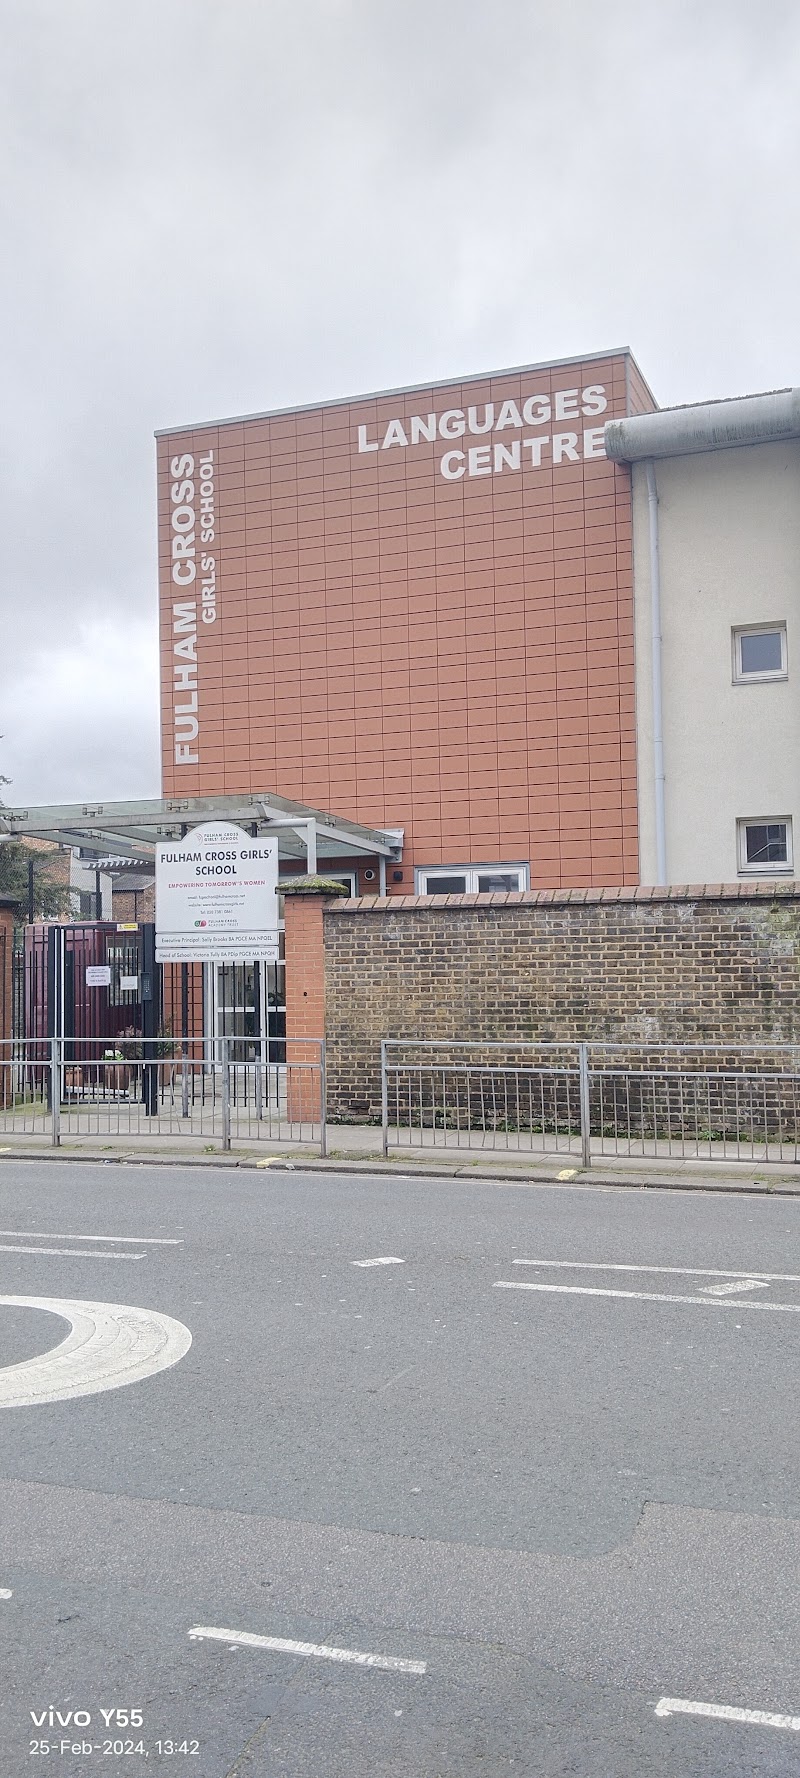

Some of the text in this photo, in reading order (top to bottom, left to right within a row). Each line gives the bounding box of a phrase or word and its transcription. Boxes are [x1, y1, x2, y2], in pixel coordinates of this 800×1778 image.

[358, 385, 608, 453] LANGUAGES
[440, 426, 607, 480] CENTRE
[200, 449, 216, 624] GIRLS' SCHOOL
[170, 453, 199, 764] FULHAM CROSS
[160, 849, 272, 863] FULHAM CROSS GIRLS'
[195, 865, 237, 876] SCHOOL
